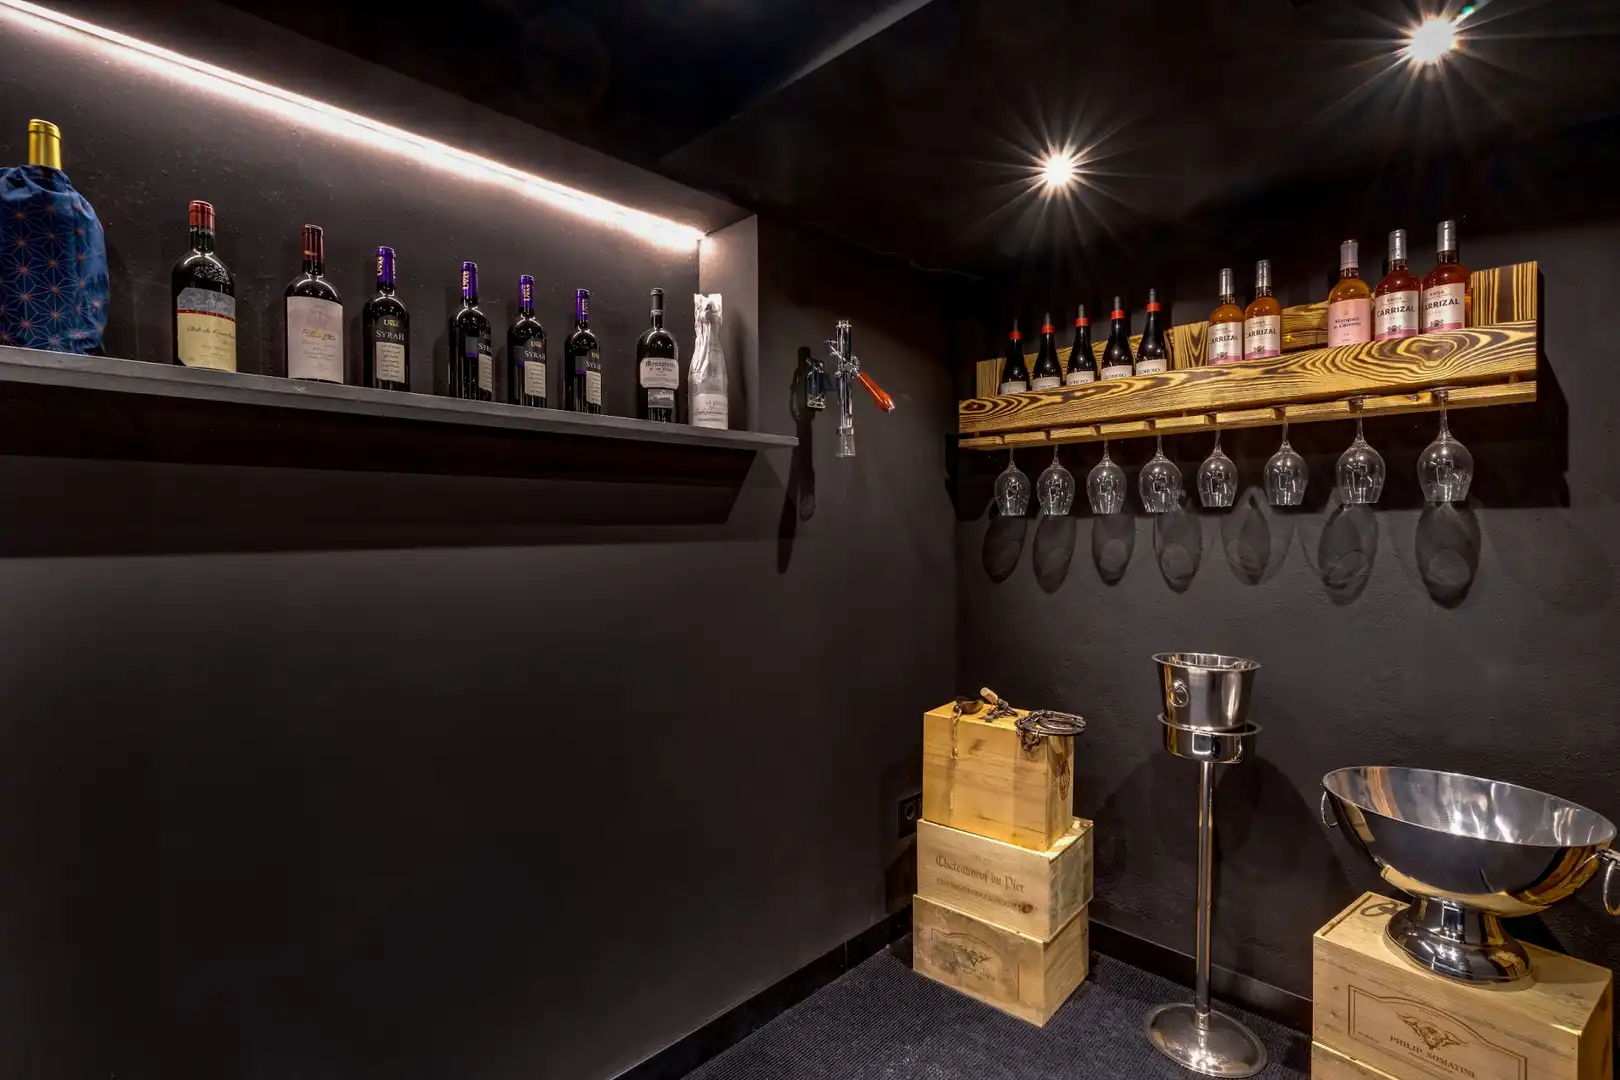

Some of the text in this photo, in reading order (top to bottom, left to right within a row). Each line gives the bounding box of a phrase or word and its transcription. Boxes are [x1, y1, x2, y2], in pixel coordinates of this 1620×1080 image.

[1376, 305, 1416, 317] CARRIZAL
[375, 329, 405, 341] SYRAH
[1245, 328, 1277, 339] CARRIZAL
[1389, 1034, 1423, 1054] PHILIP
[1426, 1052, 1476, 1079] SOMATINI
